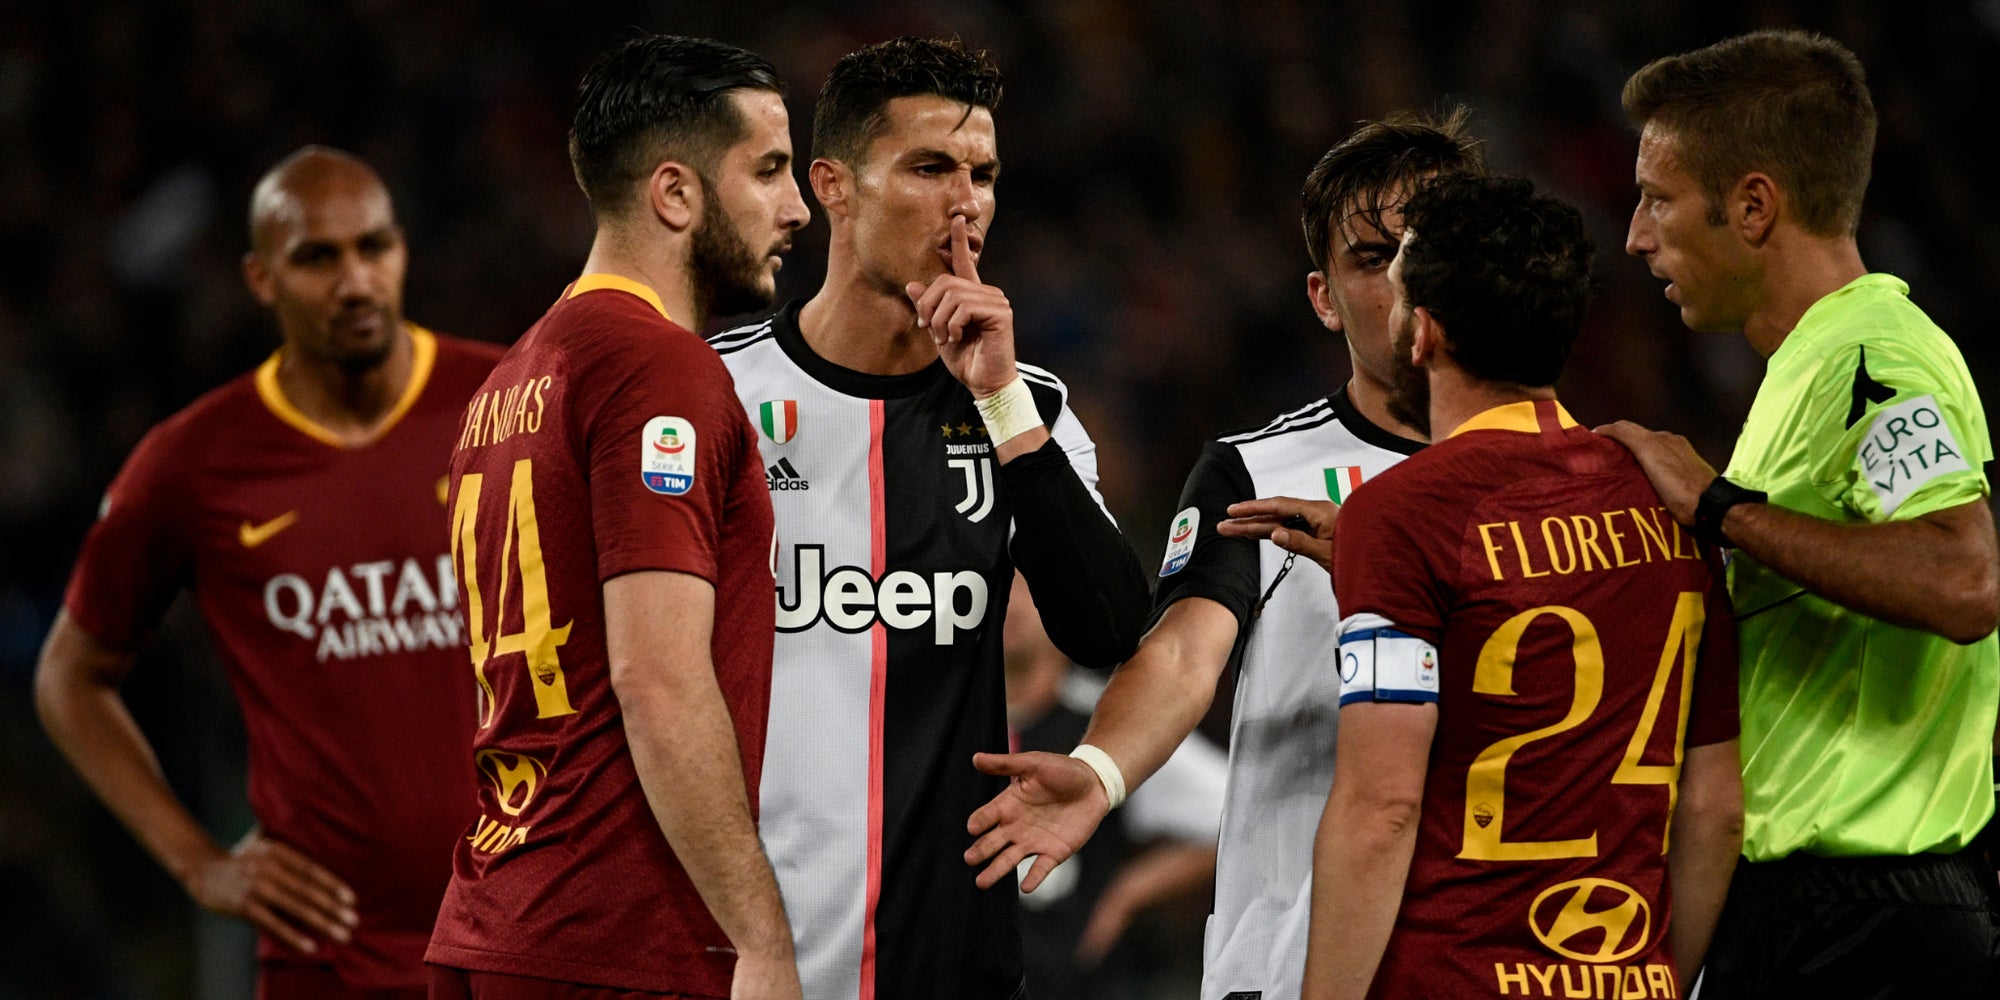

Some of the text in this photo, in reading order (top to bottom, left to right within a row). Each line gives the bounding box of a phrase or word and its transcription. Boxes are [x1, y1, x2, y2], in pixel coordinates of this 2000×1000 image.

[945, 443, 990, 455] JUVENTUS
[1861, 407, 1940, 472] EURO
[1874, 438, 1960, 494] VITA
[663, 476, 686, 490] TIM
[766, 478, 810, 491] didas
[451, 458, 579, 729] 44
[774, 543, 989, 646] Jeep
[315, 609, 469, 664] AIRWAY
[1456, 591, 1707, 862] 24
[1494, 962, 1677, 1000] HYUNDAI
